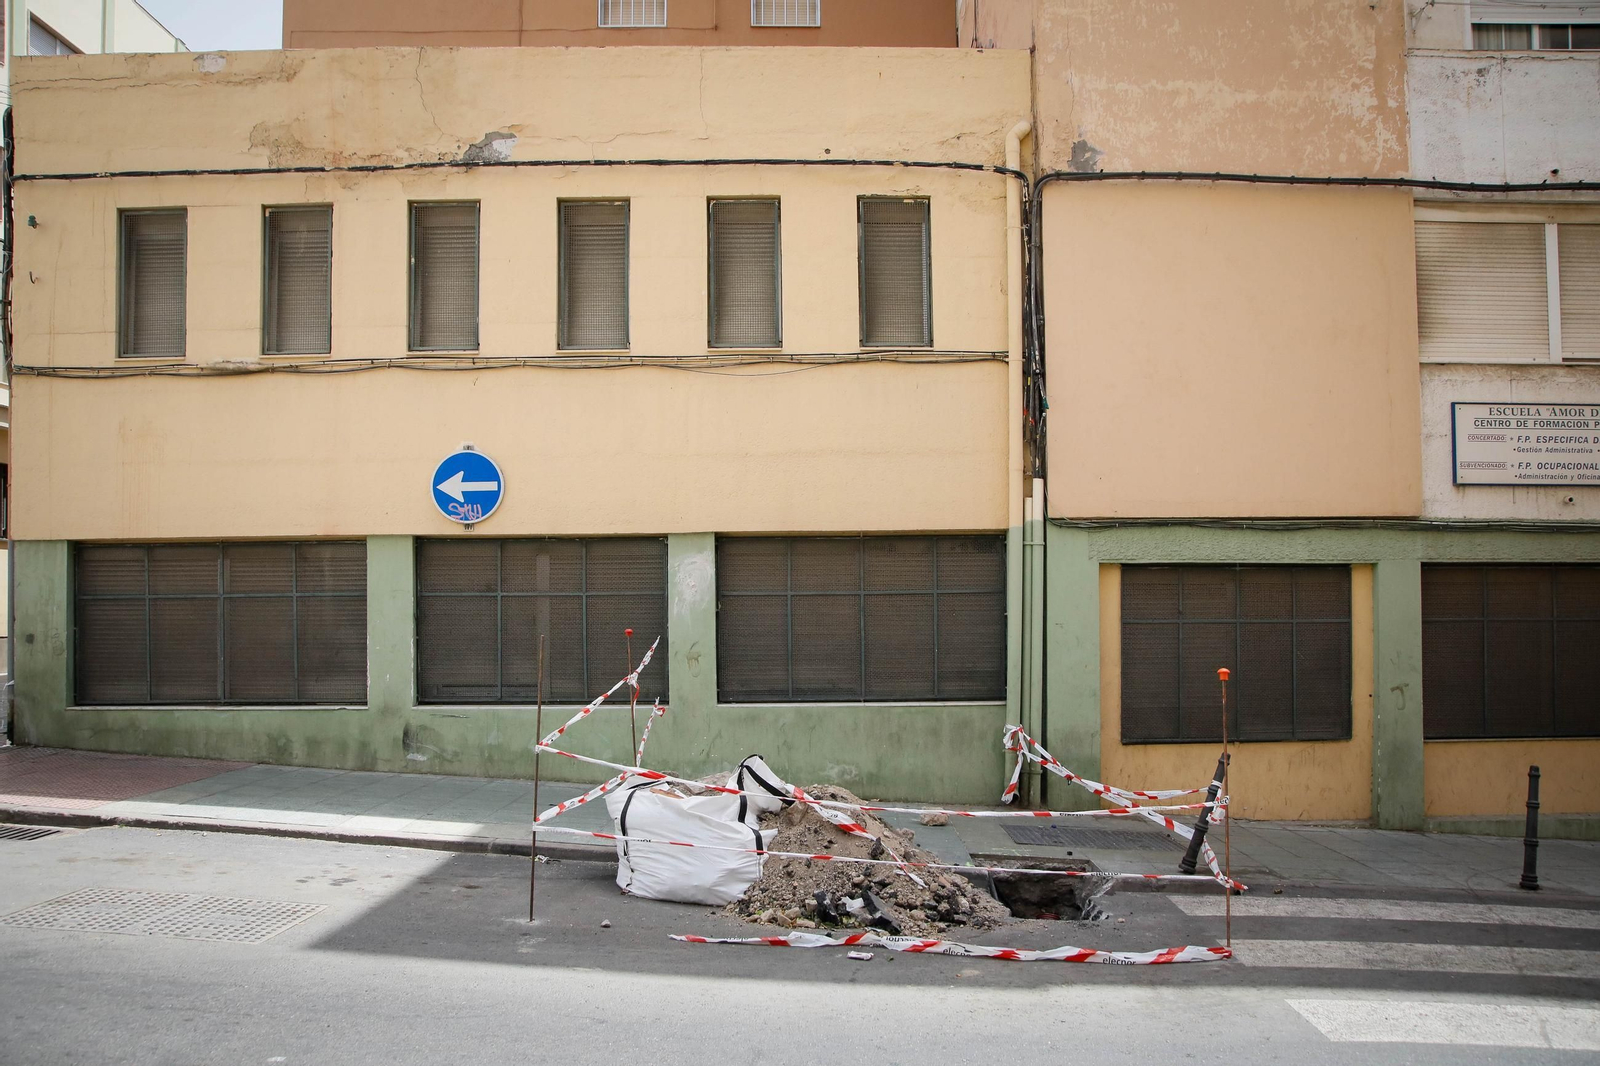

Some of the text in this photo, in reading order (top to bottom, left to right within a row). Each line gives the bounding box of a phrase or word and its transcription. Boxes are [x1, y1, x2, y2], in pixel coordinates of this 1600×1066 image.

[1489, 407, 1541, 416] ESCUELA
[1516, 420, 1528, 428] DE
[1534, 420, 1589, 428] FORMACION
